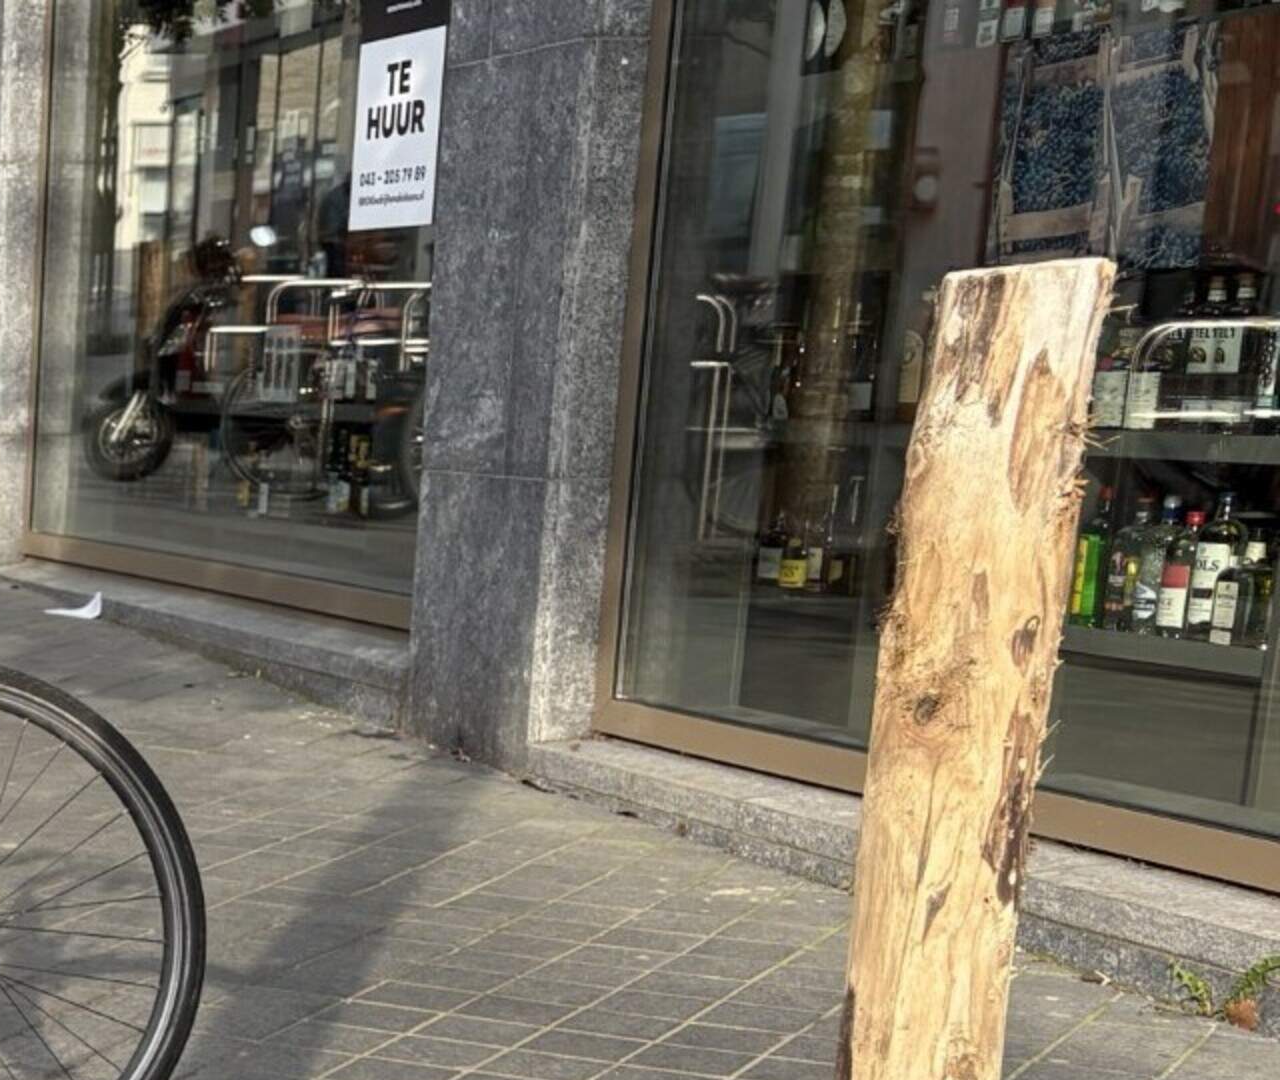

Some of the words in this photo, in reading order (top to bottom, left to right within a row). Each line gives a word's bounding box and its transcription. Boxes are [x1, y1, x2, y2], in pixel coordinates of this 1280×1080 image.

[387, 59, 412, 96] TE
[366, 100, 425, 140] HUUR
[360, 172, 376, 187] 043
